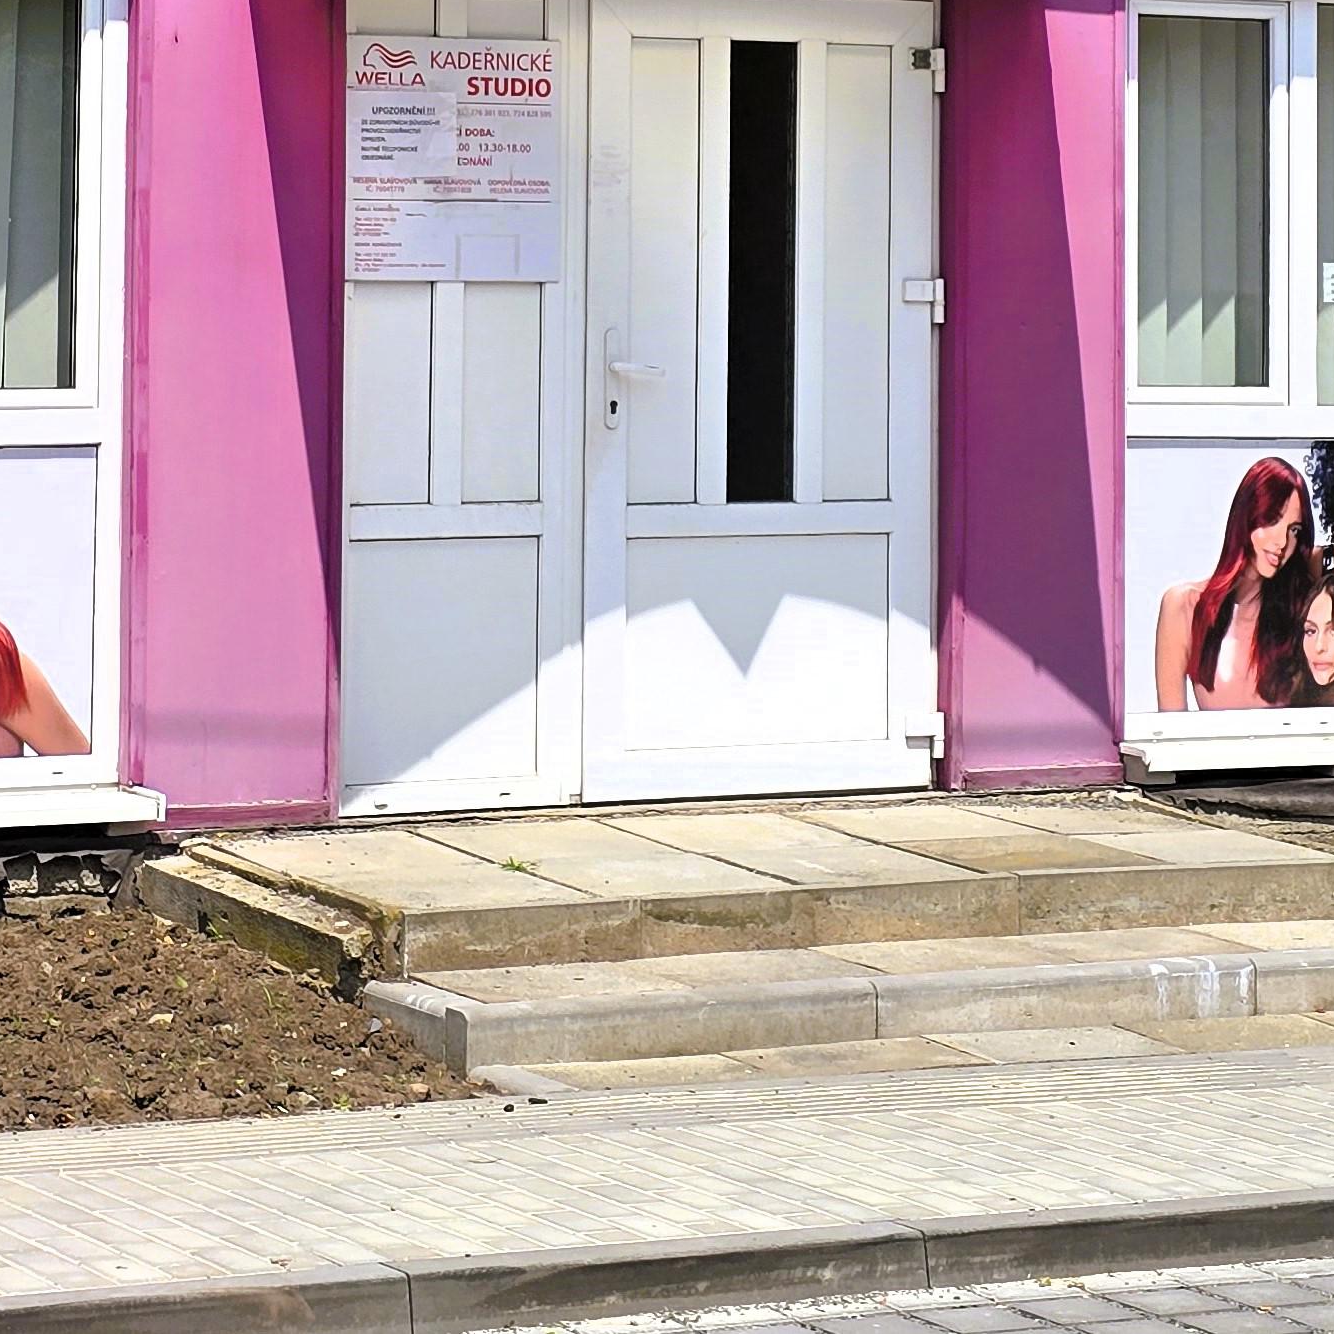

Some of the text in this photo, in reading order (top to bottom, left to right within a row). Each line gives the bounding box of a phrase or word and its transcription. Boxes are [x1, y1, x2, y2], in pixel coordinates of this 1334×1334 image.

[430, 46, 553, 72] KADEŘNICKÉ
[355, 70, 426, 86] WELLA
[467, 76, 552, 98] STUDIO
[465, 128, 495, 137] DOBA:
[479, 143, 531, 153] 13.30-18.00
